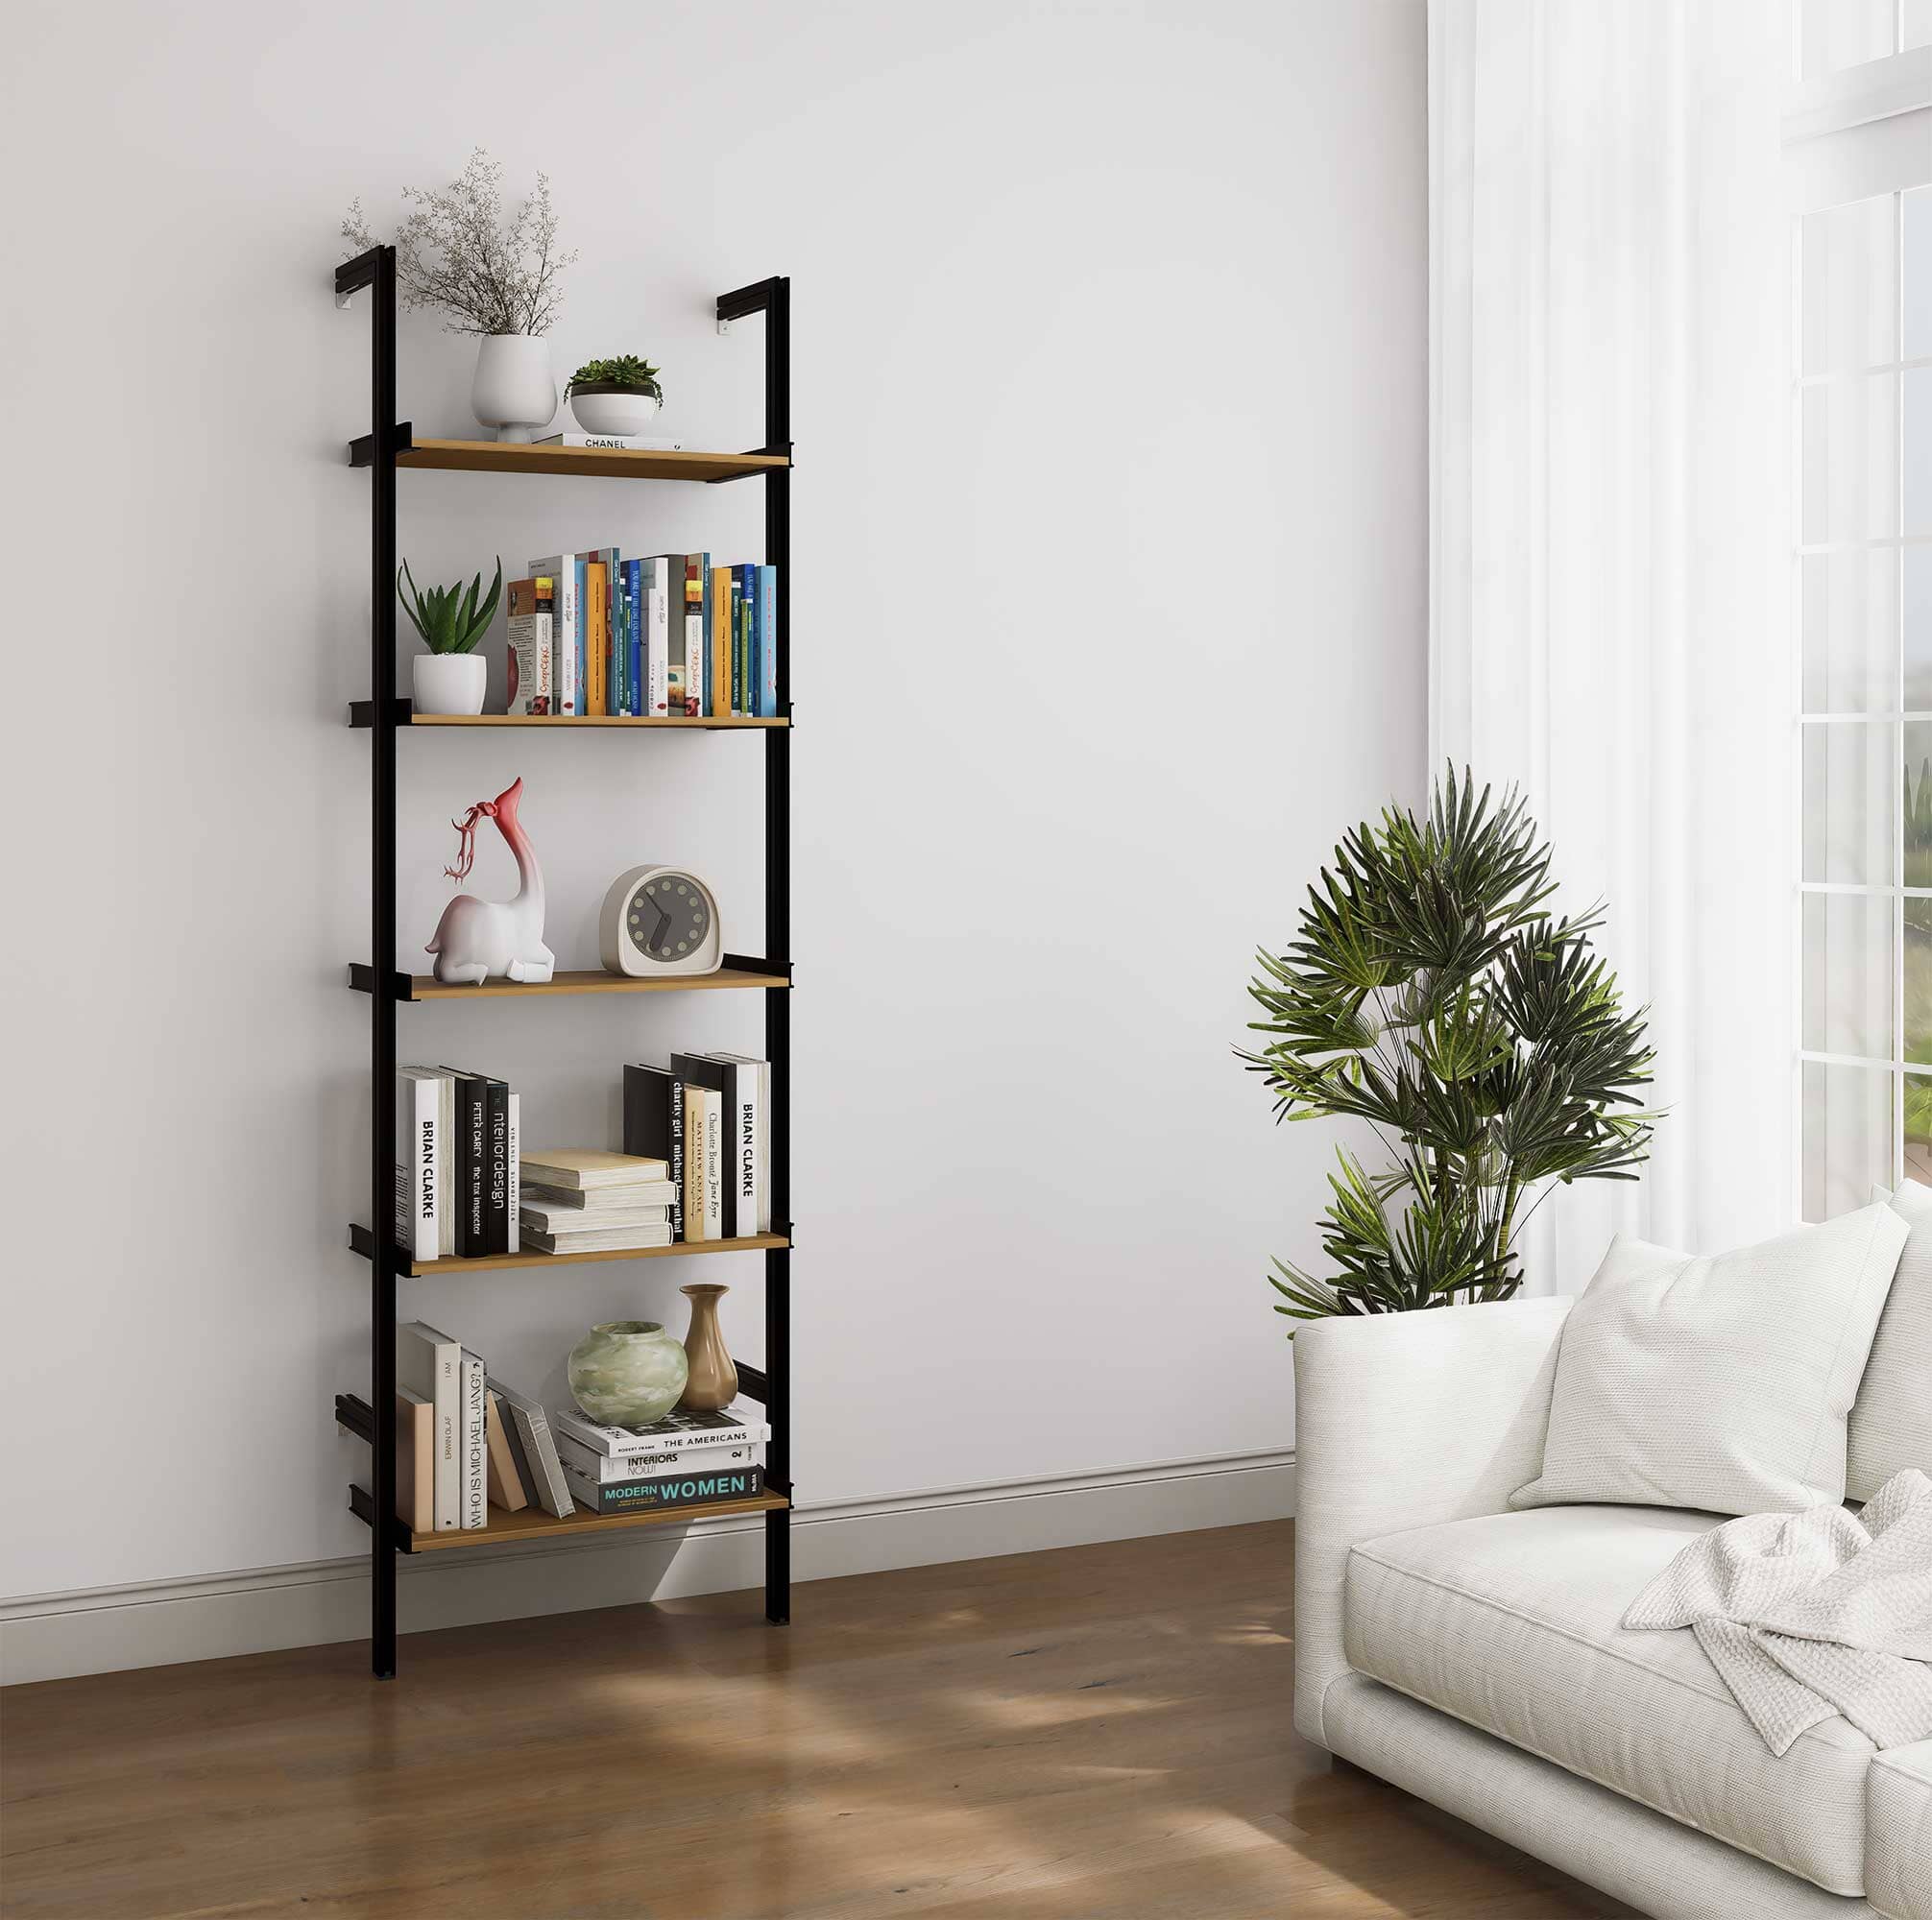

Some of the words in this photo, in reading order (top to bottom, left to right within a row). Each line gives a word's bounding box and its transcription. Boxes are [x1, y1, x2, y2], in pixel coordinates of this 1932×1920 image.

[585, 439, 626, 448] CHANEL
[671, 1082, 683, 1116] charity
[472, 1101, 483, 1128] PETER
[671, 1118, 683, 1138] girl
[743, 1104, 753, 1144] BRIAN
[423, 1121, 434, 1164] BRIAN
[472, 1130, 482, 1158] CAREY
[709, 1113, 718, 1149] Charlotte
[472, 1166, 481, 1180] the
[743, 1149, 753, 1197] CLARKE
[423, 1167, 434, 1219] CLARKE
[708, 1180, 718, 1200] Jane
[471, 1197, 481, 1236] inspector
[710, 1201, 719, 1219] Eyre
[445, 1362, 451, 1375] AM
[470, 1373, 482, 1415] JANG?
[470, 1415, 482, 1476] MICHAEL
[687, 1431, 747, 1446] AMERICANS
[627, 1452, 678, 1467] INTERIORS
[470, 1477, 482, 1491] IS
[604, 1485, 658, 1500] MODERN
[660, 1475, 745, 1500] WOMEN
[470, 1492, 482, 1528] WHO
